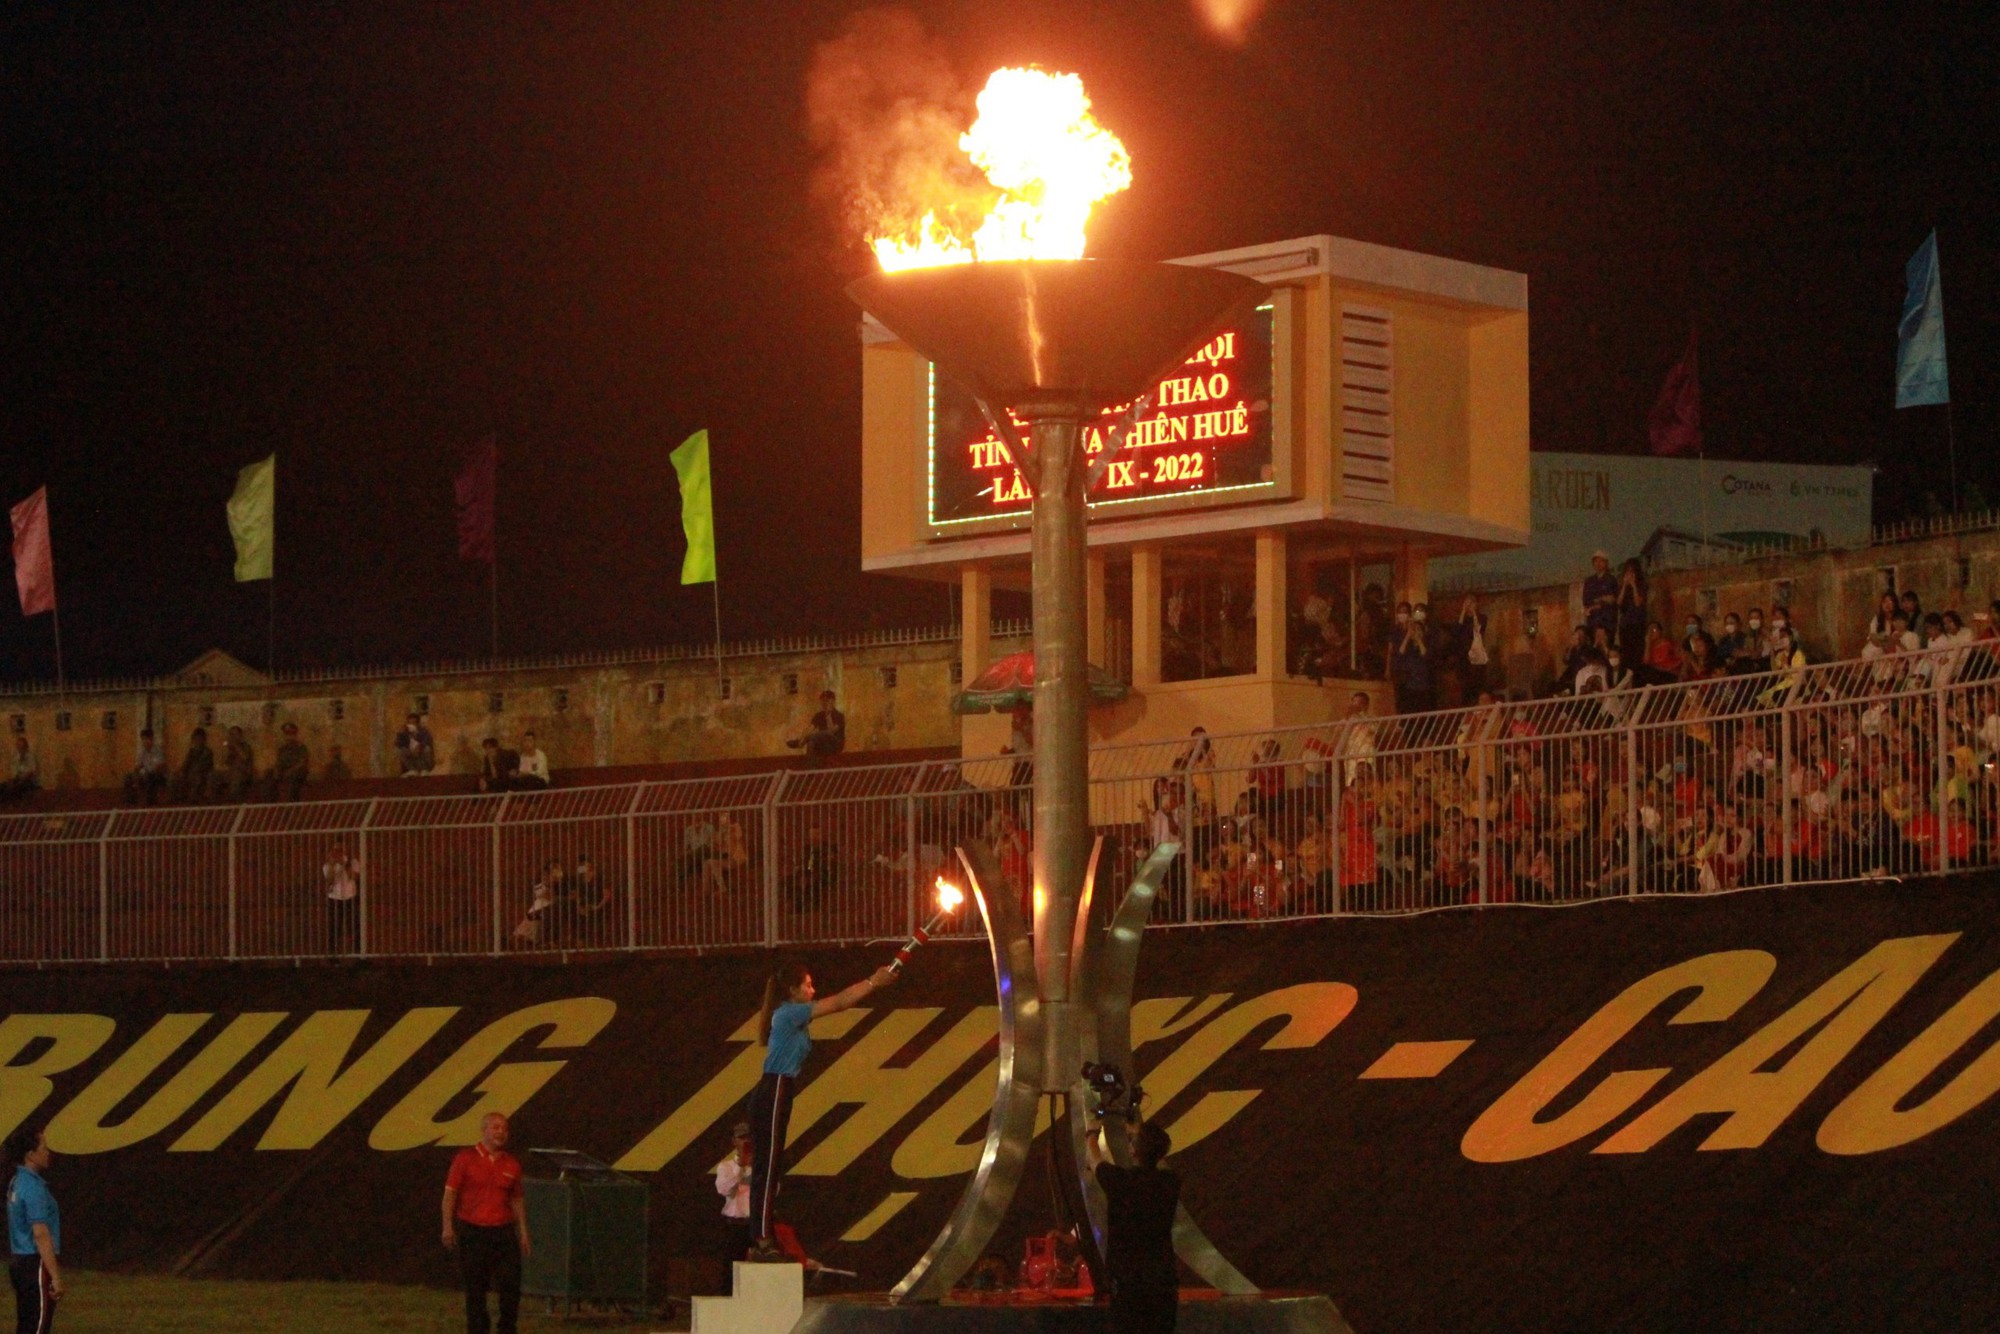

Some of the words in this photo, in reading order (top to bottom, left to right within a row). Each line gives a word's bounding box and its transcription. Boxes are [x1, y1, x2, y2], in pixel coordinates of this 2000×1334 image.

[1158, 373, 1229, 407] THAO
[1193, 401, 1249, 440] HUẾ
[1107, 461, 1135, 489] IX
[1153, 452, 1204, 483] 2022
[1722, 474, 1771, 494] COTANA
[1358, 1040, 1475, 1079] -
